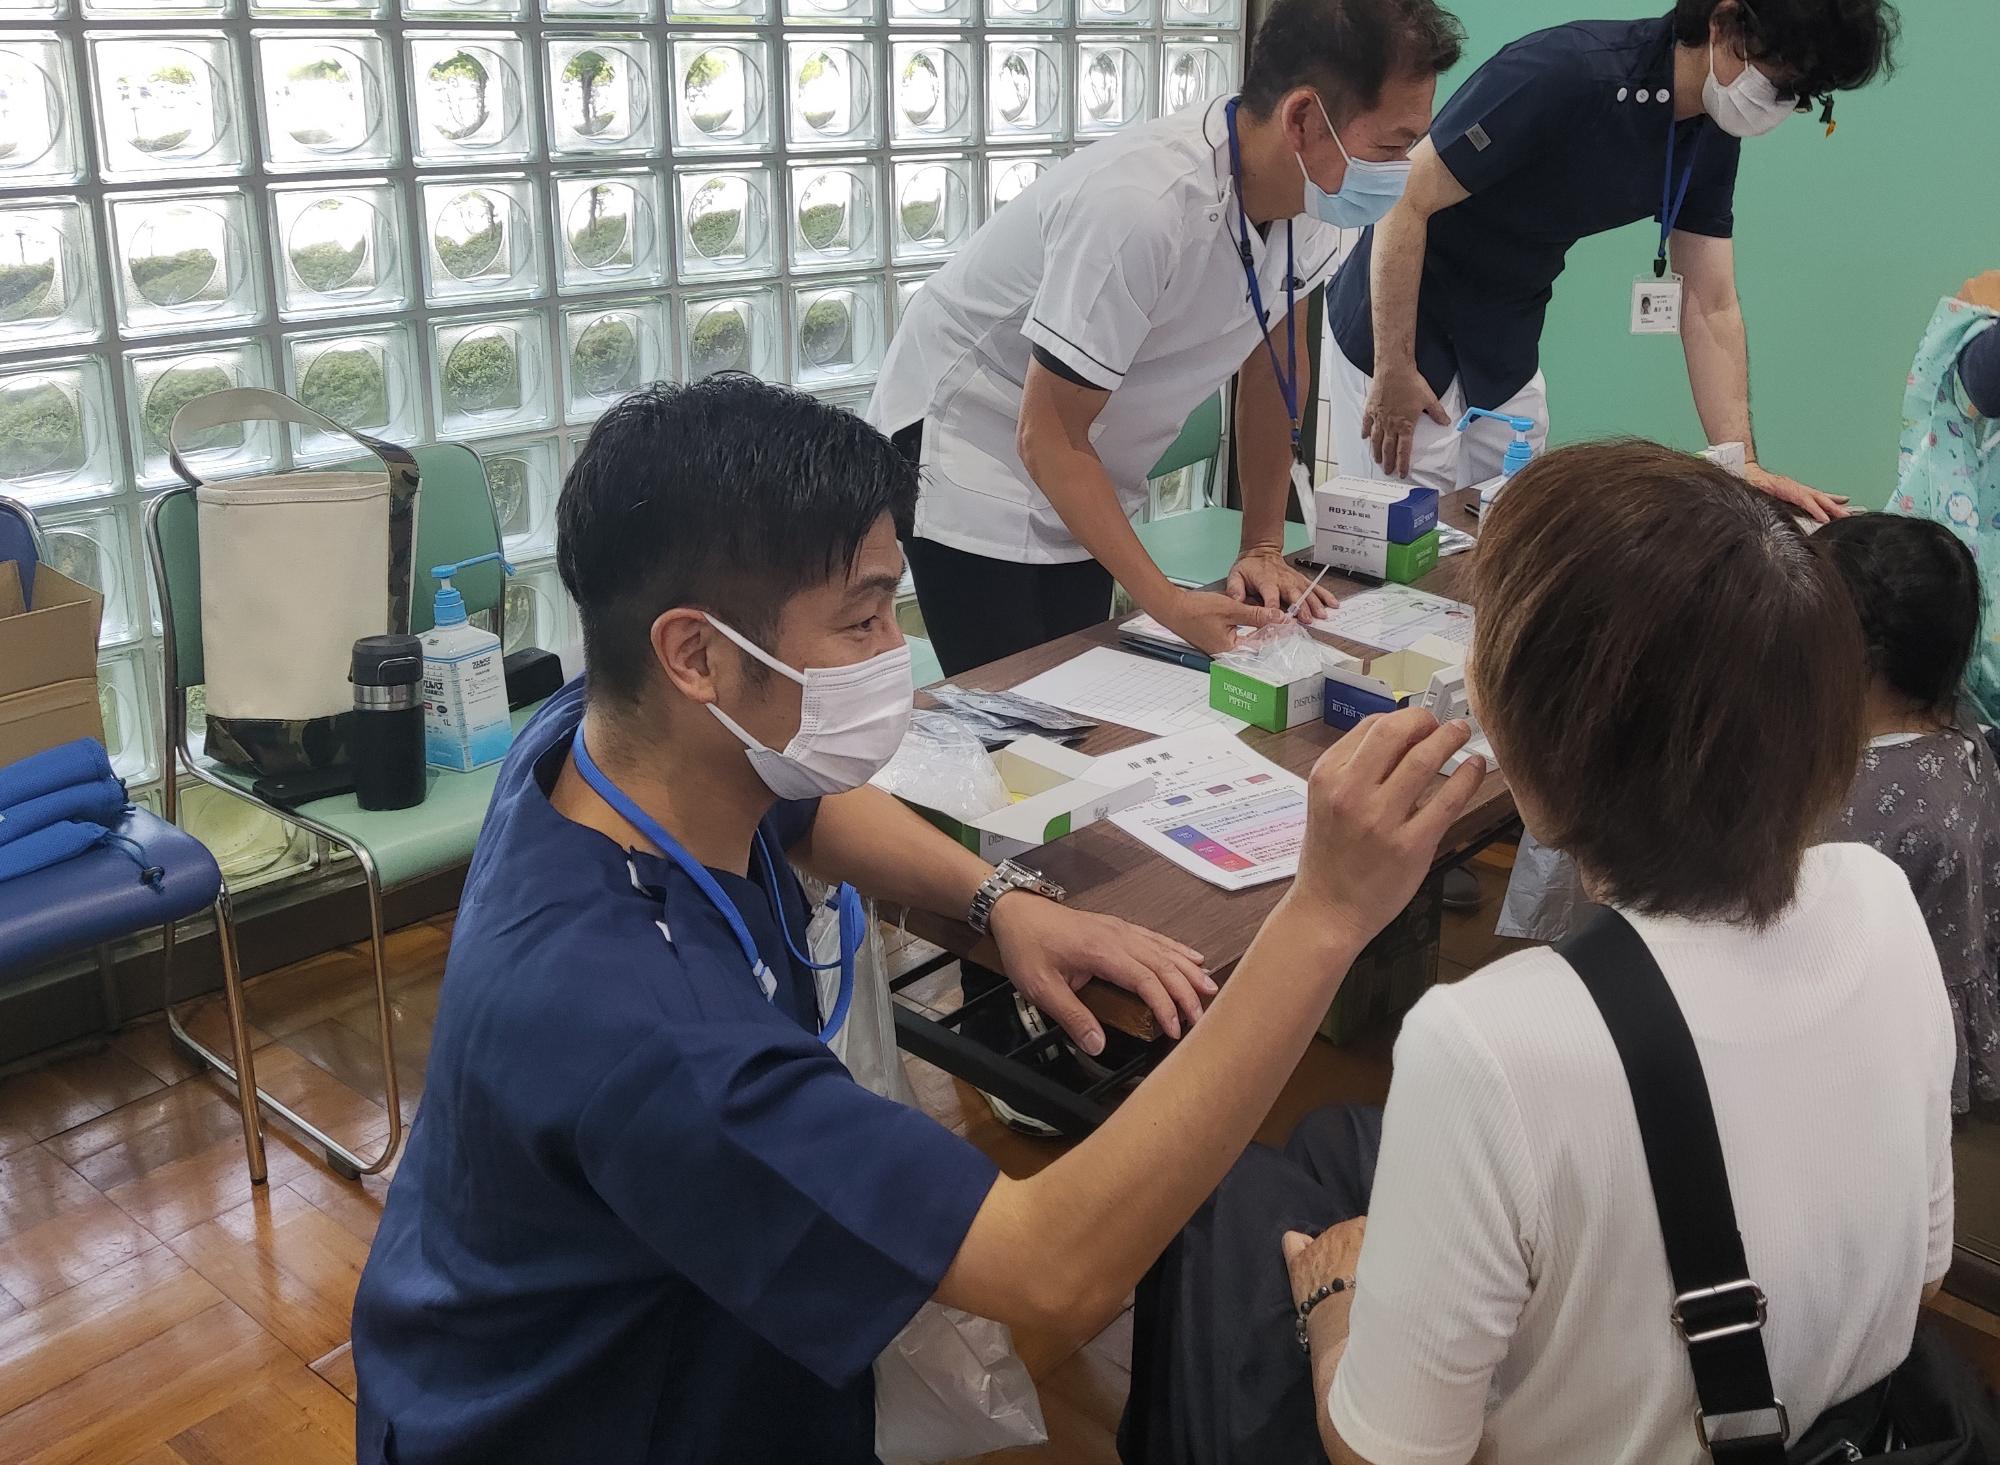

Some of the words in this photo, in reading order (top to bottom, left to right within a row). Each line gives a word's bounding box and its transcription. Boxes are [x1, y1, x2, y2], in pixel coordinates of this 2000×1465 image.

[1223, 681, 1258, 702] DISPOSABLE
[1228, 694, 1252, 711] PIPETTE
[1342, 706, 1357, 718] TEST
